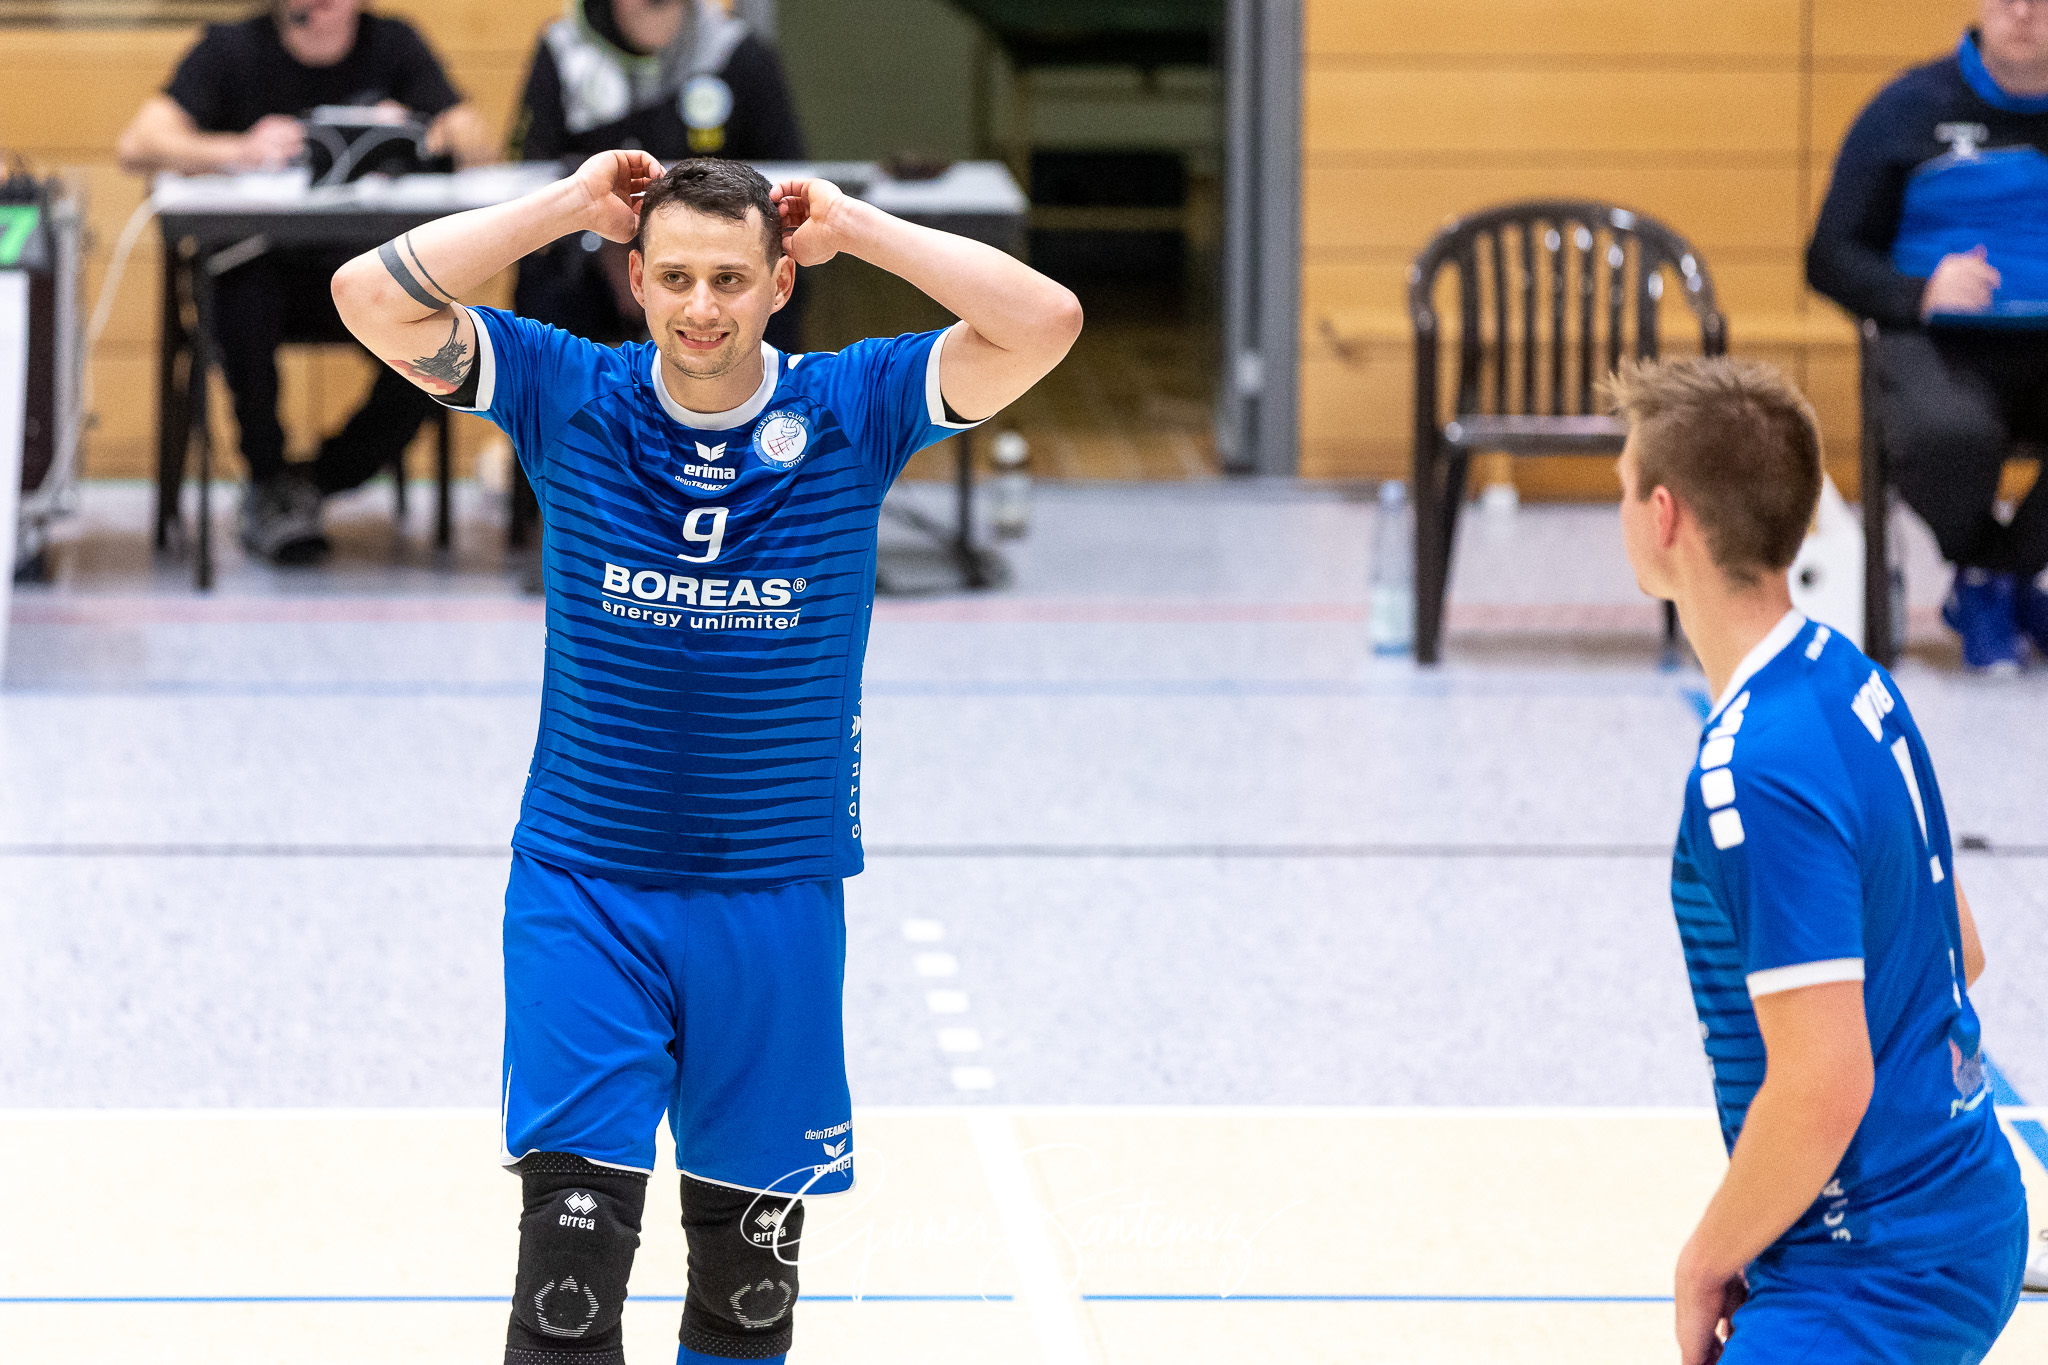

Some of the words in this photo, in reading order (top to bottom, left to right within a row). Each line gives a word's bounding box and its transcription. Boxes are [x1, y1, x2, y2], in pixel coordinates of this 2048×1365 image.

[753, 411, 786, 442] VOLLEYBALL
[786, 411, 805, 423] CLUB
[683, 463, 736, 480] erima
[782, 454, 806, 468] GOTHA
[677, 506, 730, 563] 9
[602, 599, 682, 628] energy
[690, 612, 801, 630] unlimited
[849, 740, 861, 838] GOTHA
